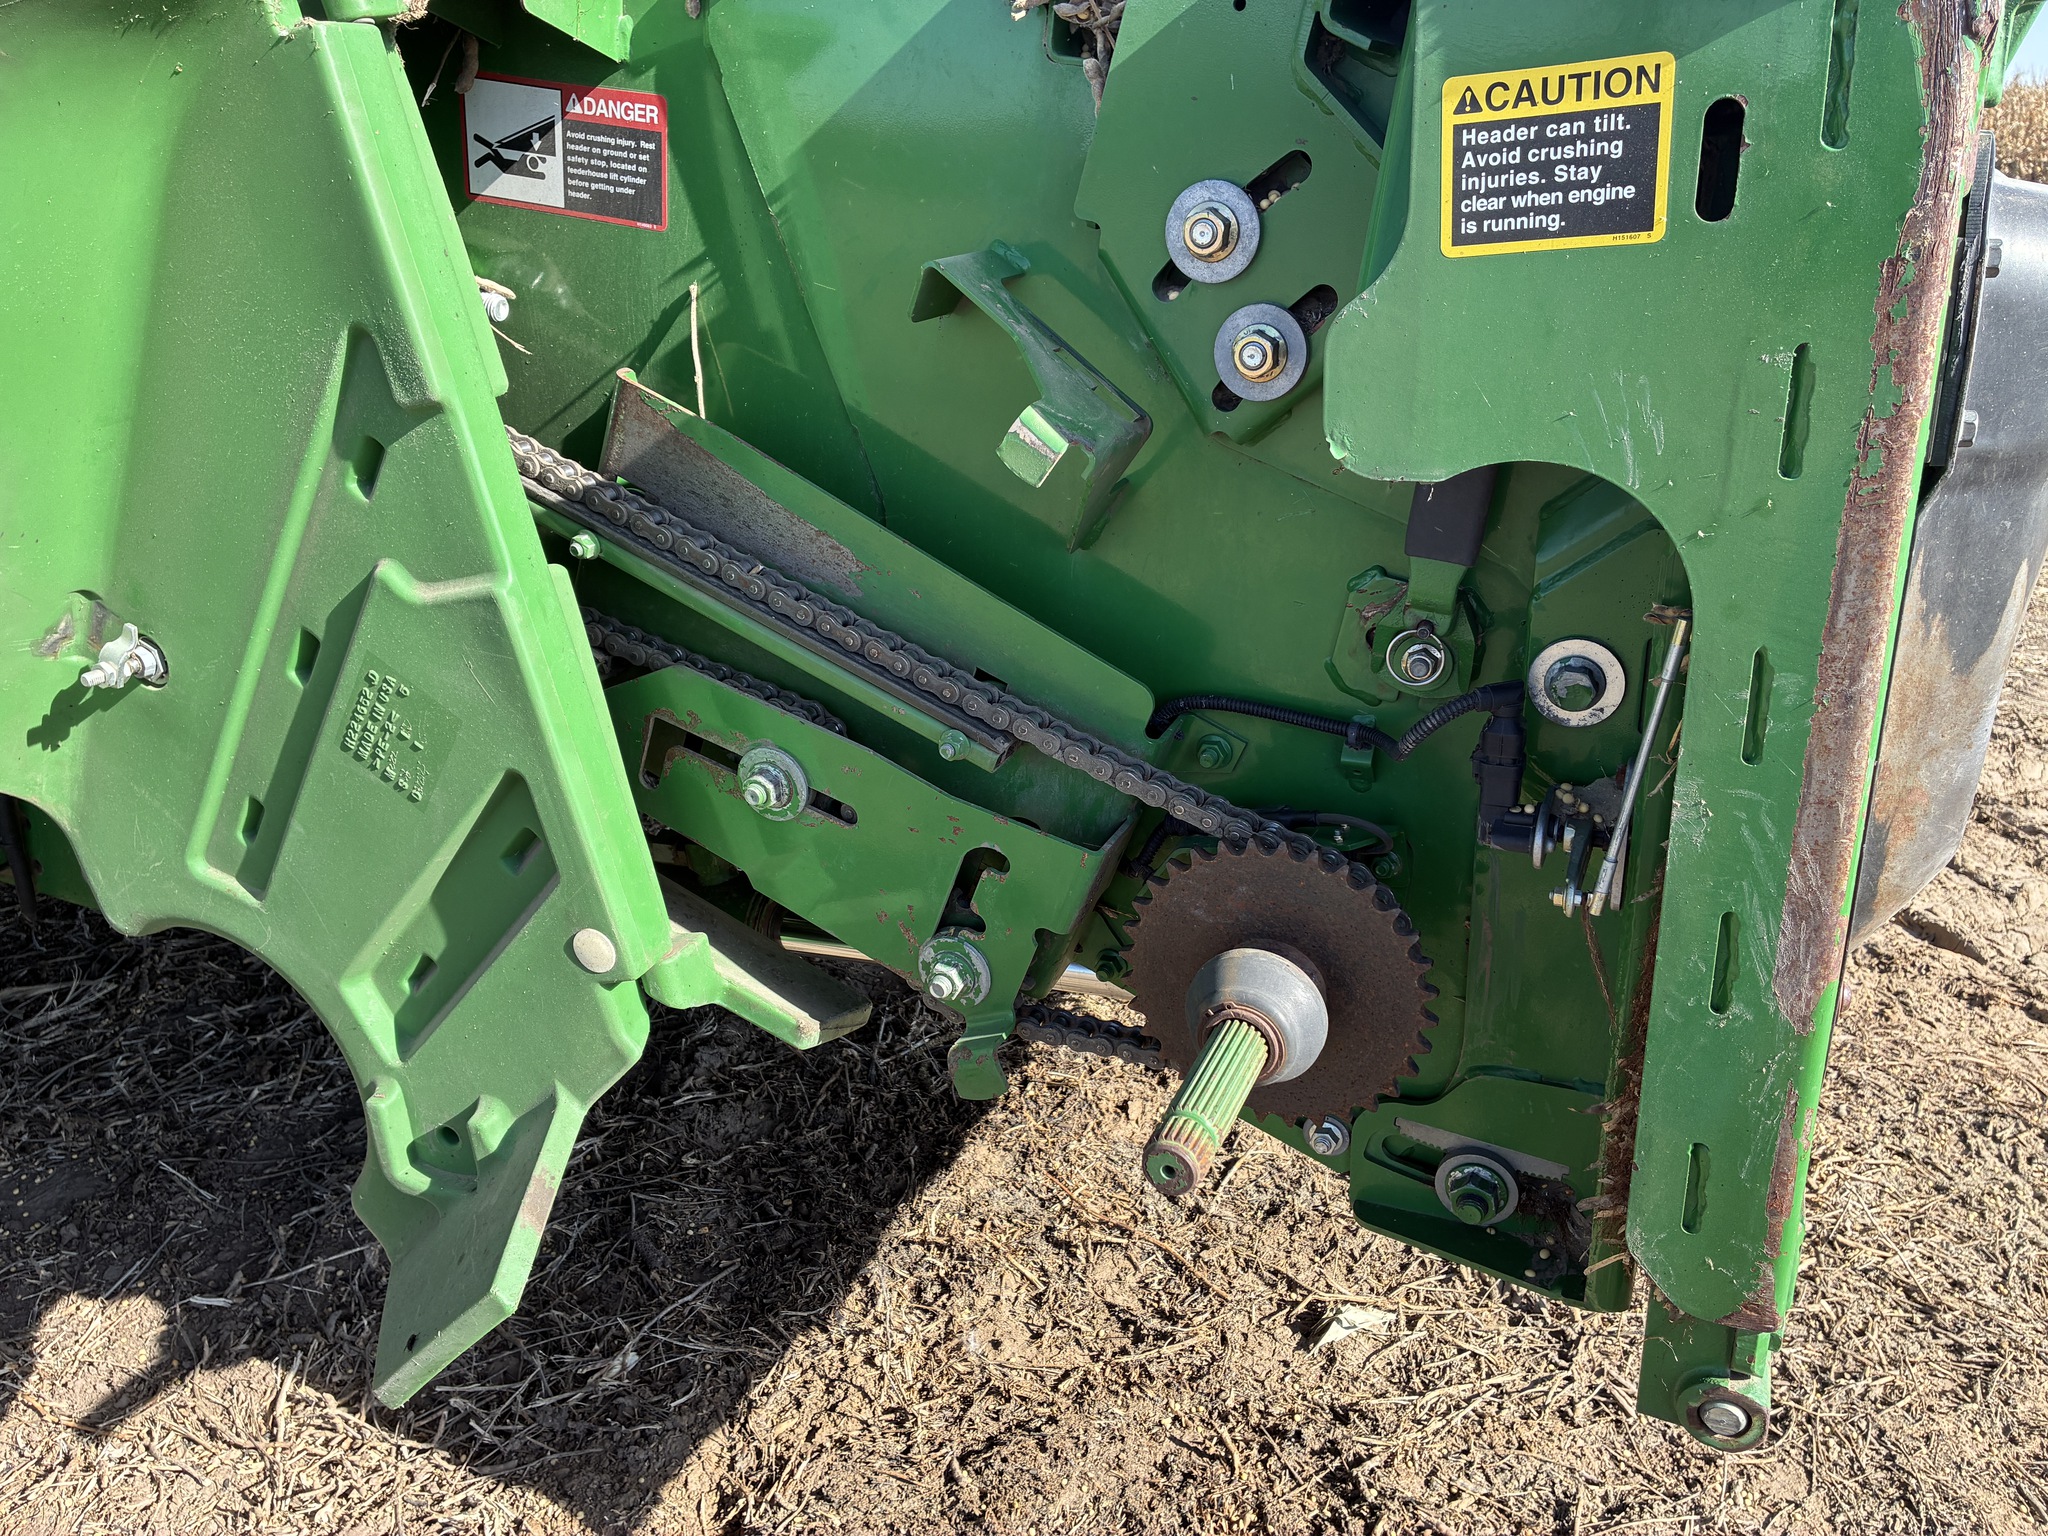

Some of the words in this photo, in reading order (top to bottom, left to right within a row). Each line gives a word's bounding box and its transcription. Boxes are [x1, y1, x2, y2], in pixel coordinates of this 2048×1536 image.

[1485, 63, 1661, 111] CAUTION
[583, 96, 659, 124] DANGER
[566, 130, 585, 140] Avoid
[586, 134, 616, 146] crushing
[616, 137, 637, 149] injury.
[640, 140, 656, 150] Rest
[1462, 124, 1538, 146] Header
[1546, 120, 1585, 138] can
[1594, 113, 1631, 133] tilt.
[566, 142, 591, 152] header
[591, 147, 601, 155] on
[602, 149, 628, 158] ground
[1461, 147, 1521, 168] Avoid
[1528, 139, 1623, 163] crushing
[566, 155, 589, 166] safety
[590, 158, 609, 169] stop,
[610, 160, 637, 171] located
[567, 166, 609, 179] feederhouse
[609, 172, 619, 181] lift
[620, 174, 647, 185] cylinder
[567, 177, 590, 188] before
[590, 182, 615, 194] getting
[615, 186, 636, 195] under
[1461, 170, 1546, 193] injuries.
[1554, 164, 1602, 184] Stay
[567, 189, 593, 200] header.
[1460, 195, 1507, 213] clear
[1511, 190, 1563, 208] when
[1568, 183, 1636, 206] engine
[1461, 217, 1477, 234] is
[1483, 213, 1566, 233] running.
[378, 675, 397, 703] USA
[372, 702, 386, 721] IN
[357, 721, 379, 760] MADE
